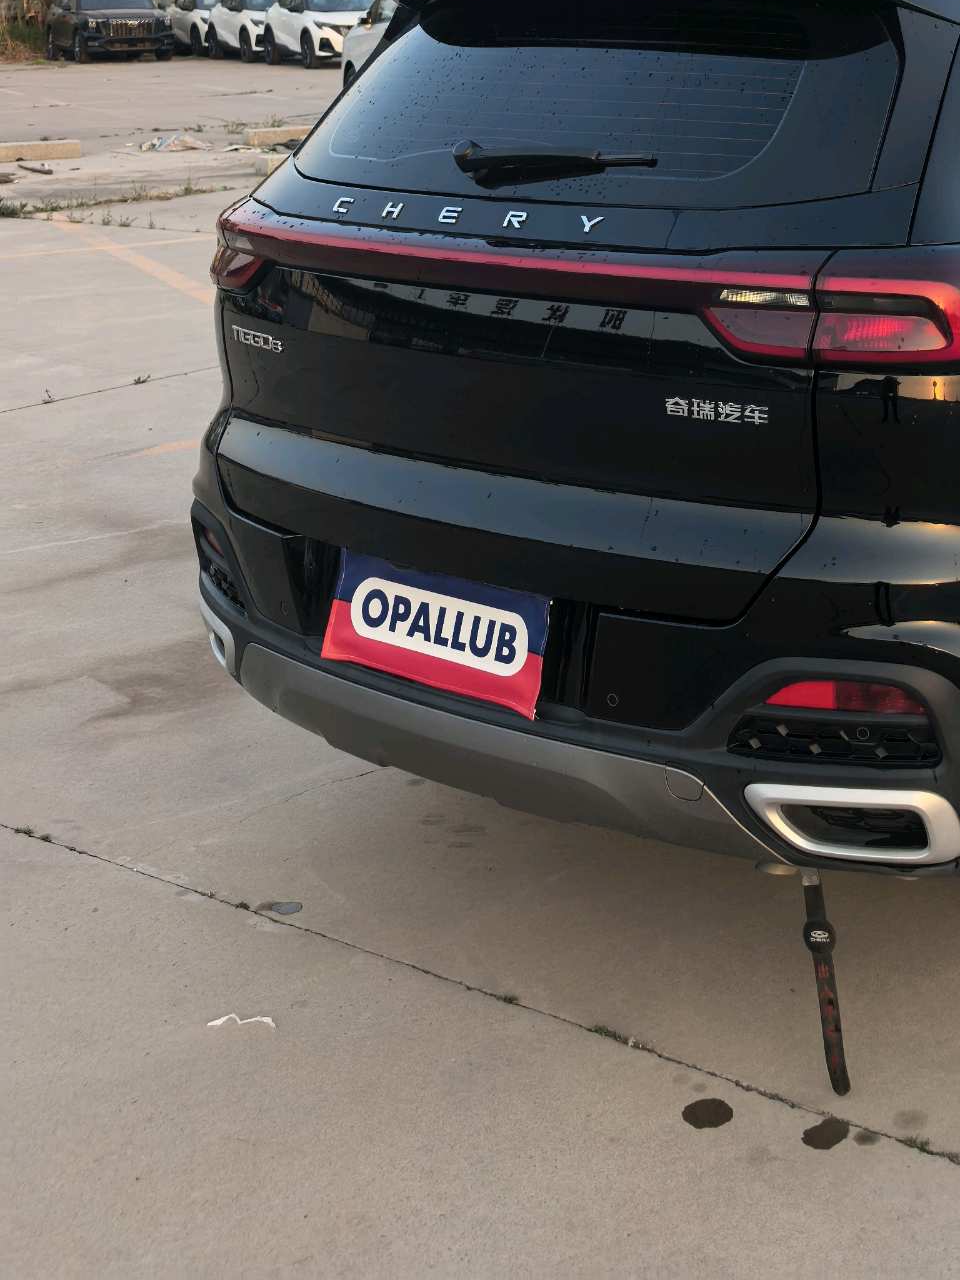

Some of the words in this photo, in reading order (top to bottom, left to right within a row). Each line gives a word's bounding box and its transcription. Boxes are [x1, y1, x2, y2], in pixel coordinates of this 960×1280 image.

[332, 197, 605, 233] CHERY
[665, 397, 769, 425] 奇瑞汽车
[361, 588, 518, 665] OPALLUB
